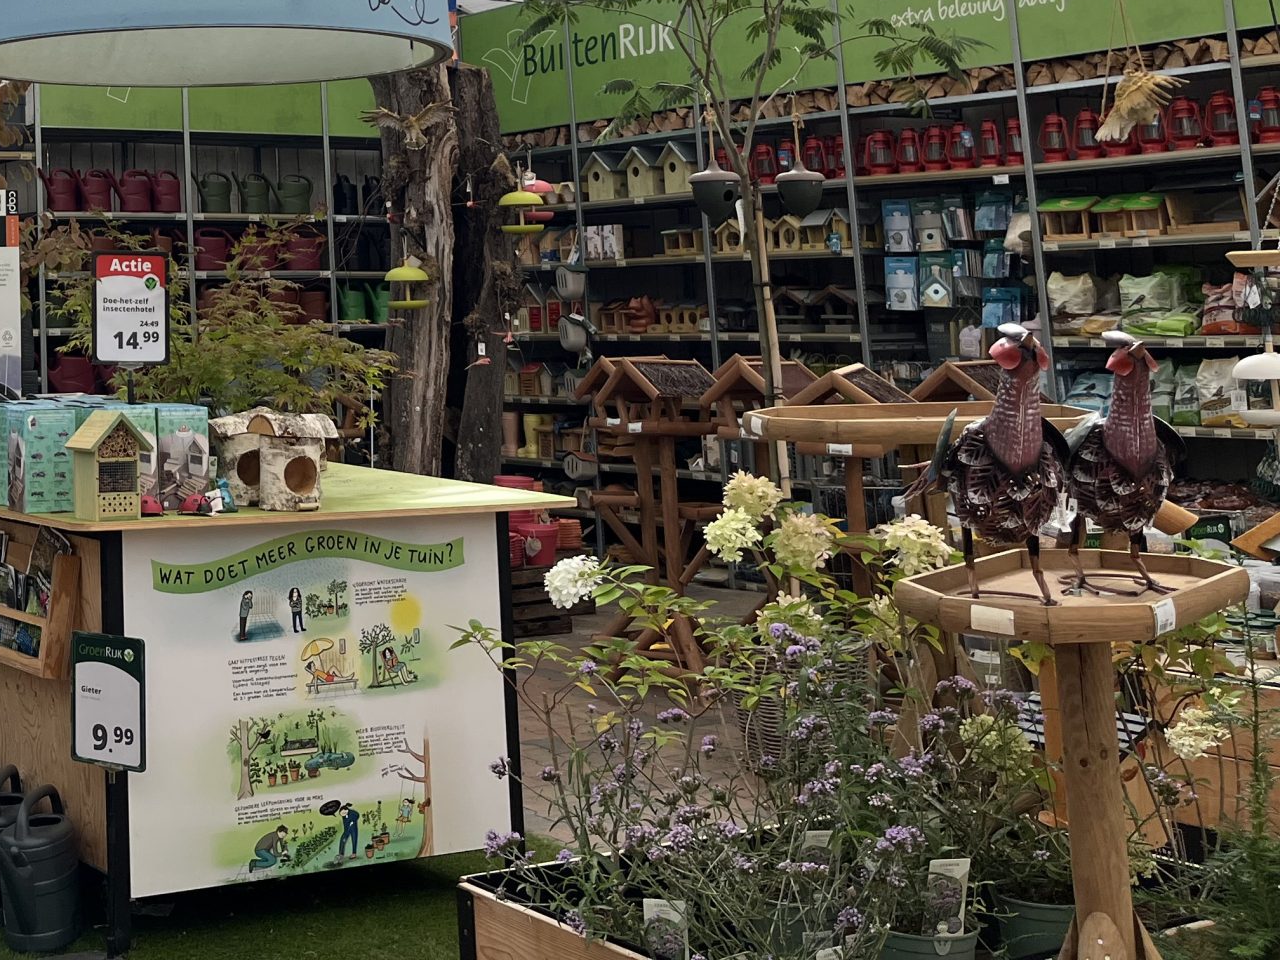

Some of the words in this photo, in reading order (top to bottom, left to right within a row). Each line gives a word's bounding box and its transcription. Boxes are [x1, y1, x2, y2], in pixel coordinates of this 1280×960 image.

[890, 6, 935, 29] extra
[109, 258, 152, 272] Actie
[103, 297, 149, 305] Doe-het-zelf
[102, 305, 155, 313] insectenhotel
[160, 568, 195, 585] WAT
[204, 559, 249, 585] DOET
[255, 541, 297, 569] MEER
[305, 535, 358, 553] GROEN
[81, 685, 102, 695] Gieter
[92, 723, 135, 753] 9.99
